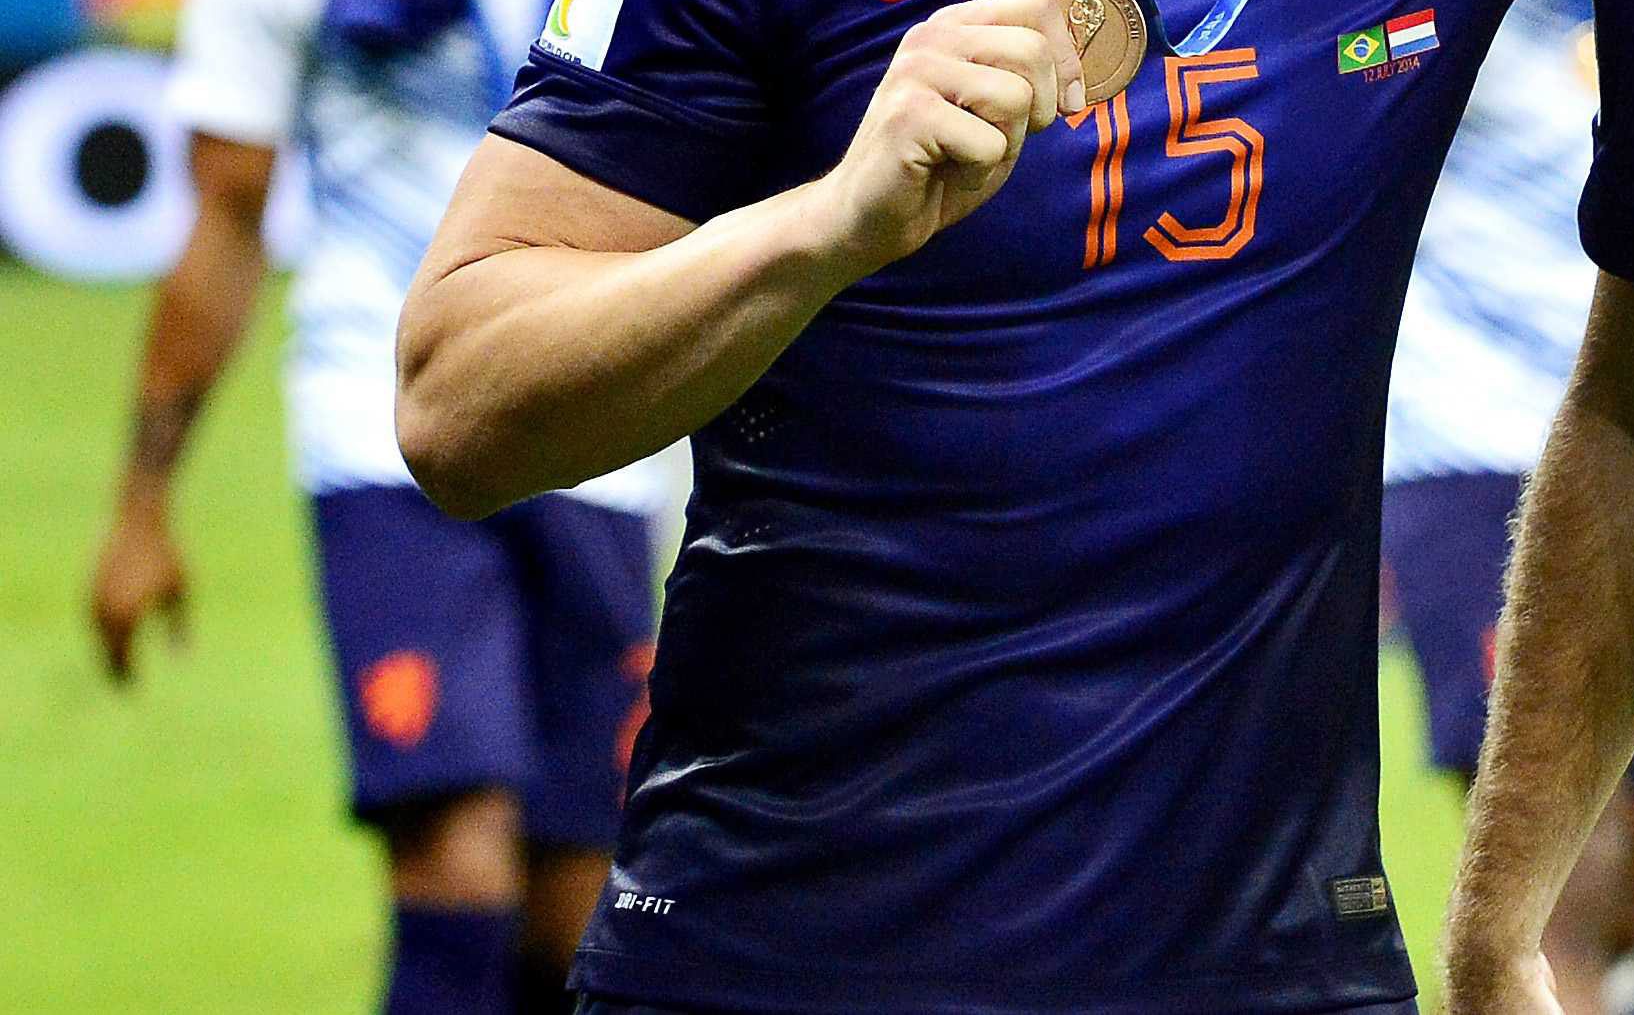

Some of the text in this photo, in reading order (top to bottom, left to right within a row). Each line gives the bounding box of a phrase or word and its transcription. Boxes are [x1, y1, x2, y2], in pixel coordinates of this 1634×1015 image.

[1363, 56, 1420, 83] 12 JULY 2014
[1057, 47, 1265, 270] 15
